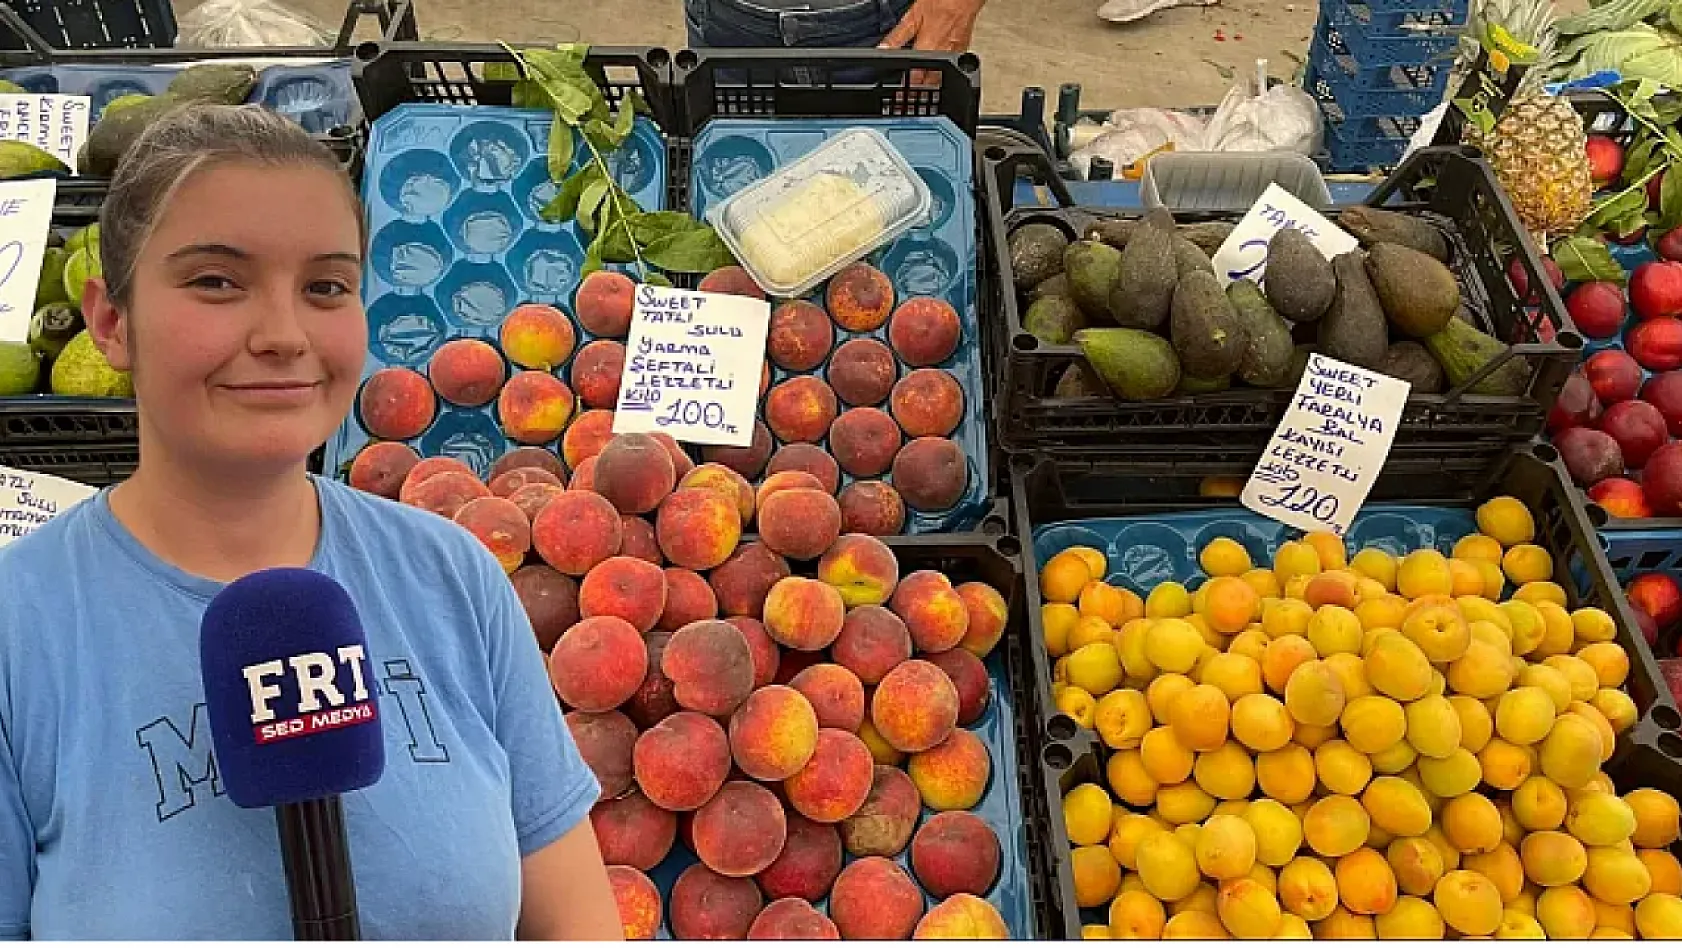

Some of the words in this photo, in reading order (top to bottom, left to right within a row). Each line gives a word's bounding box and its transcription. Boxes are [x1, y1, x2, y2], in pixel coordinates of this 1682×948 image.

[637, 286, 707, 310] SWEET
[638, 336, 712, 357] YARMA
[1308, 356, 1378, 388] SWEET
[241, 644, 370, 724] FRT
[261, 721, 304, 740] SED
[311, 705, 373, 730] MEDYA
